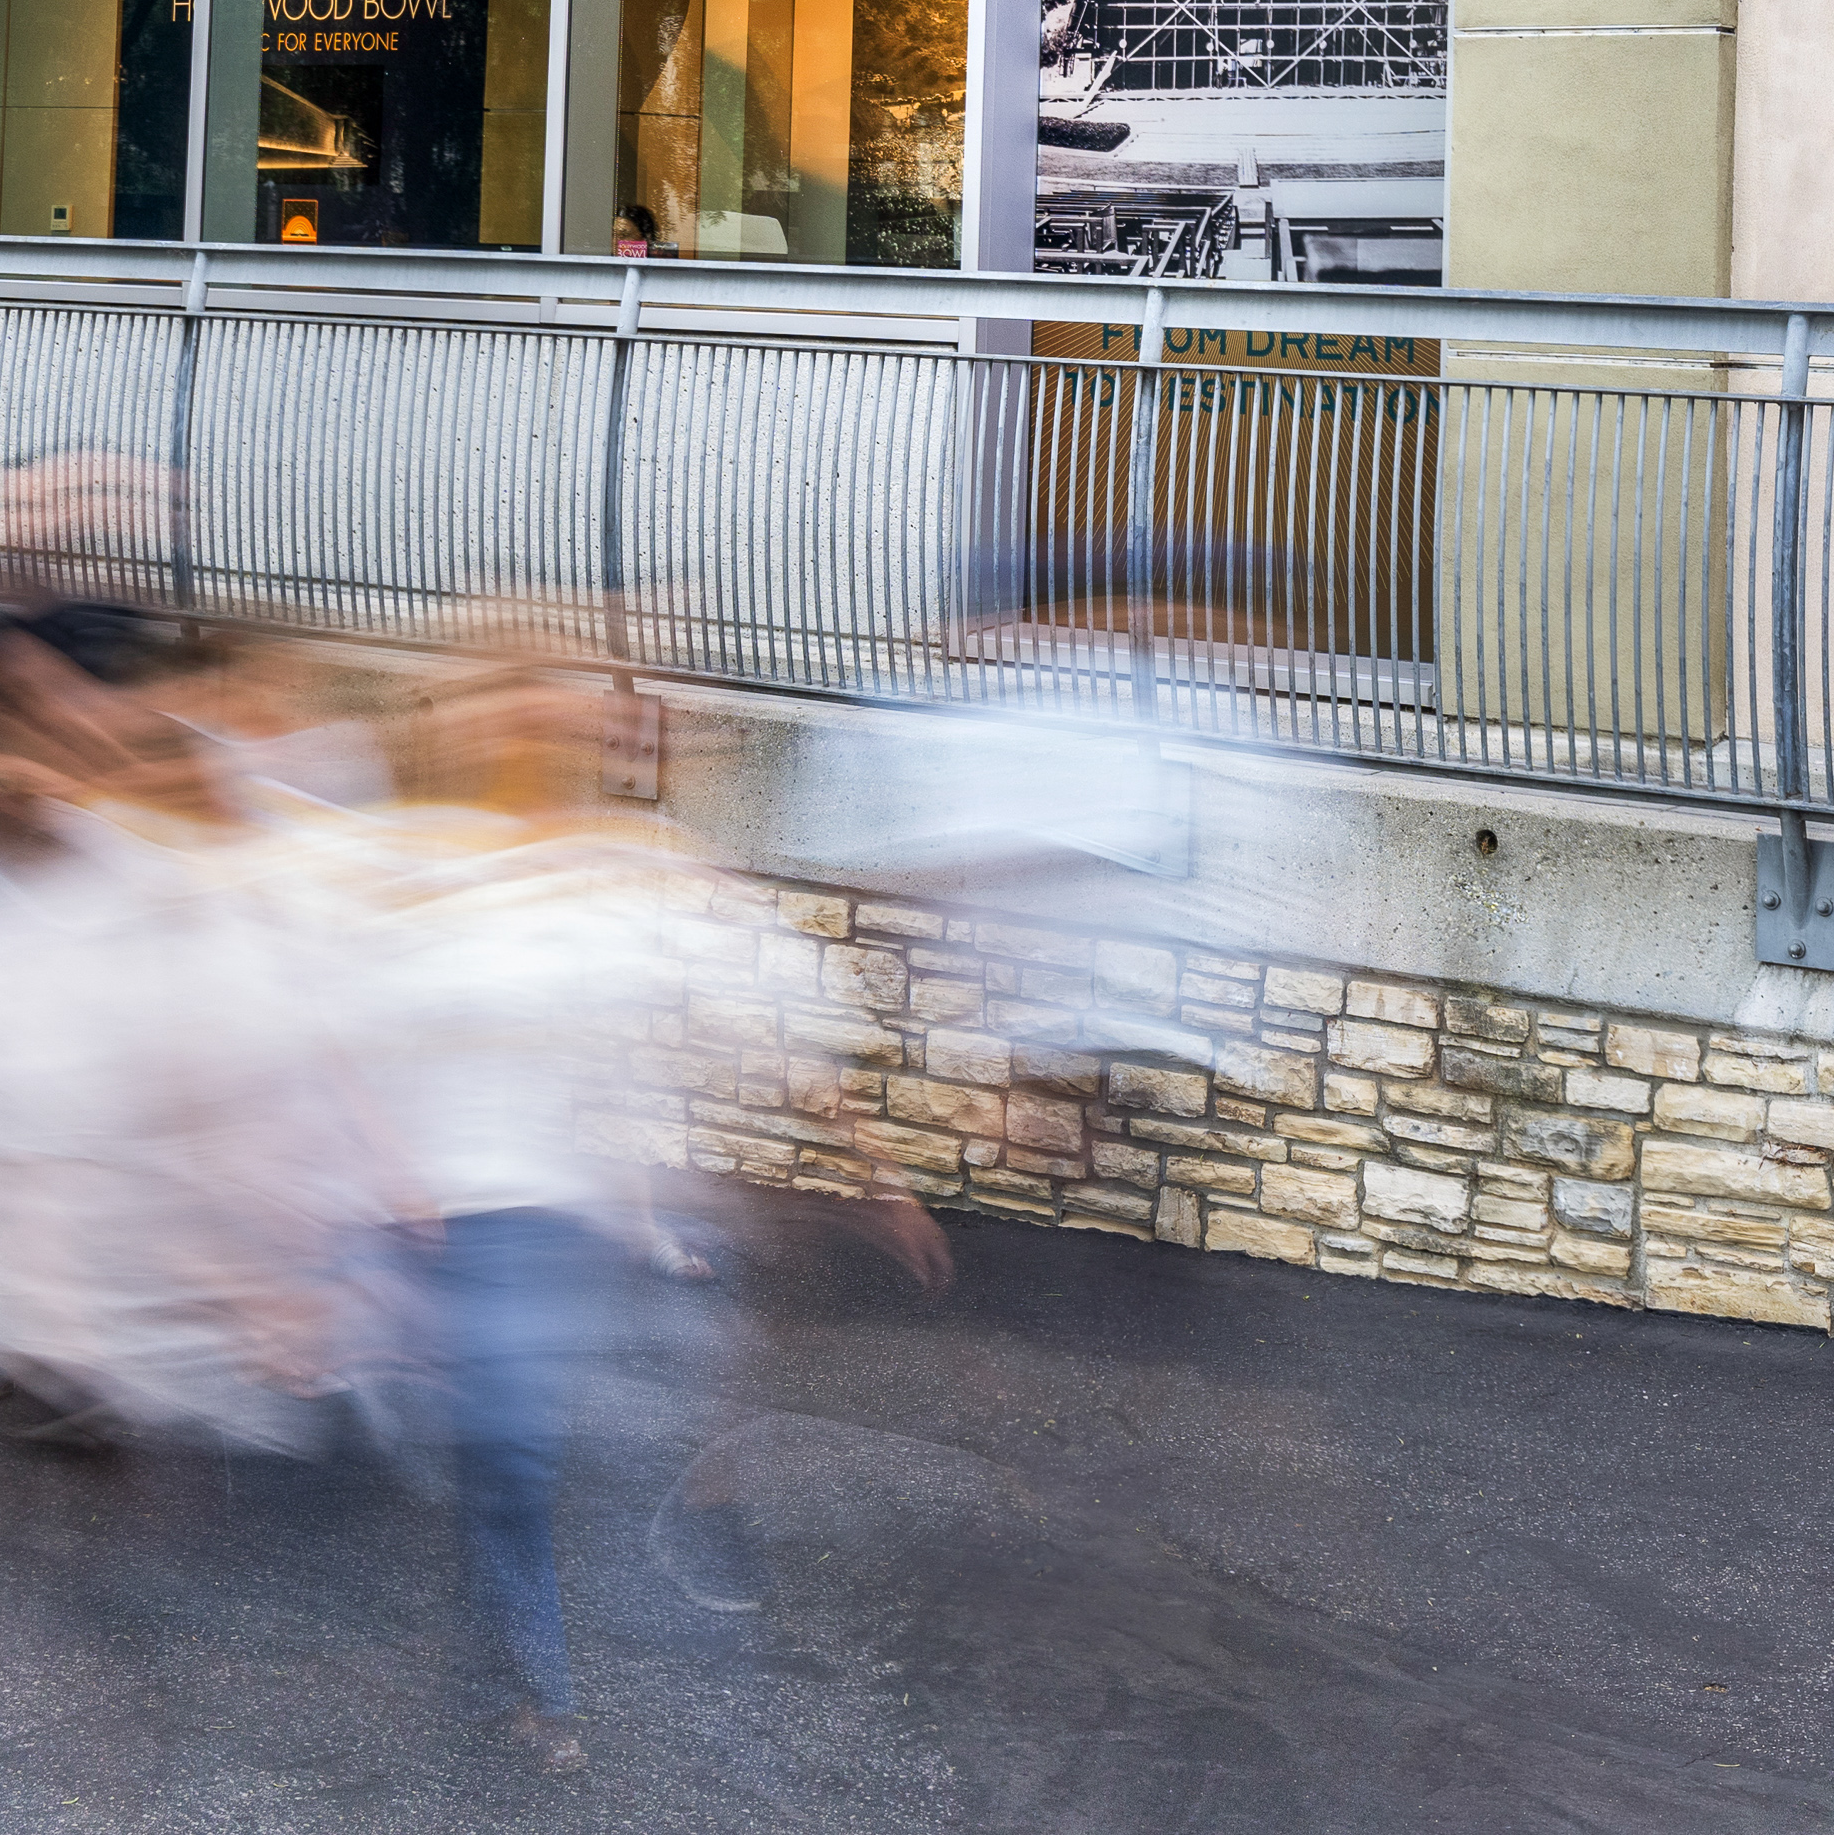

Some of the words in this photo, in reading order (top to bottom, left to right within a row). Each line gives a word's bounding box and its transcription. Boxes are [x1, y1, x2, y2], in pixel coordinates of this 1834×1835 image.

[277, 32, 307, 51] FOR
[314, 31, 399, 51] EVERYONE
[1246, 331, 1414, 364] DREAM
[1065, 372, 1116, 407] TO
[1161, 376, 1440, 425] ESTINATION
